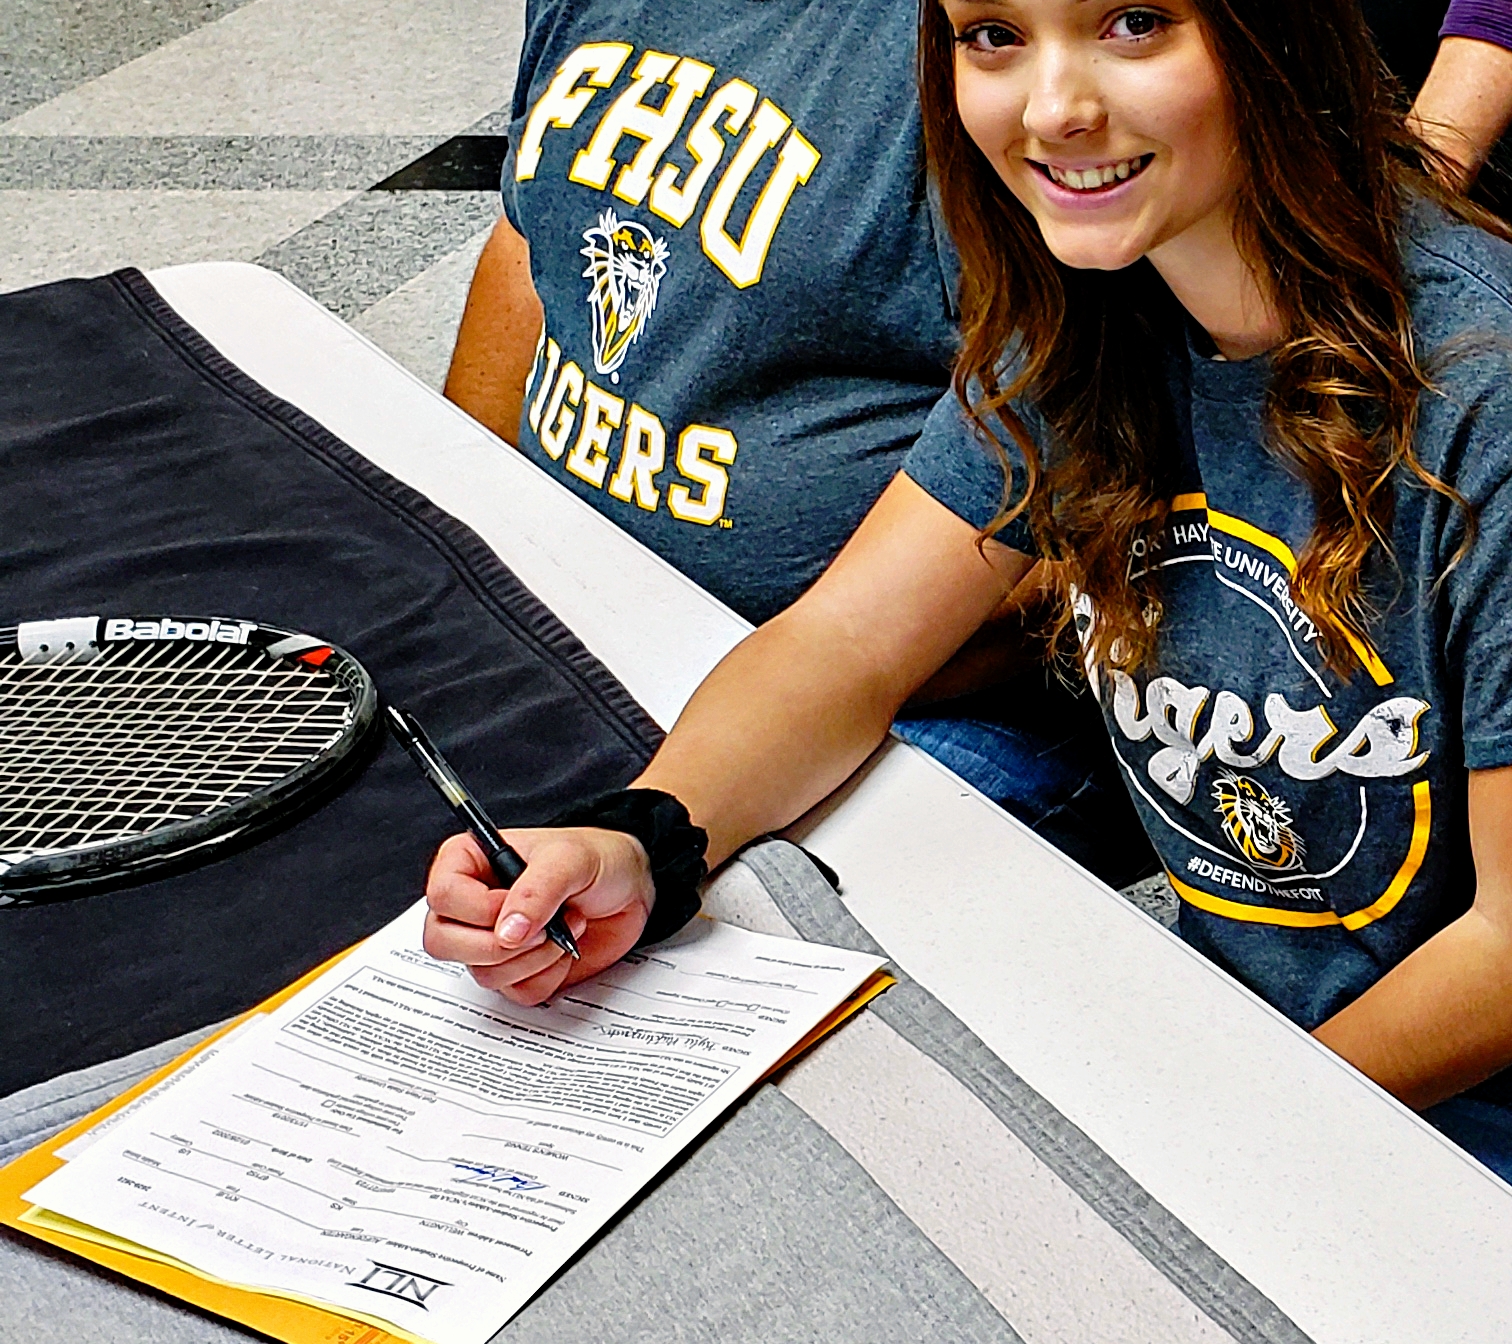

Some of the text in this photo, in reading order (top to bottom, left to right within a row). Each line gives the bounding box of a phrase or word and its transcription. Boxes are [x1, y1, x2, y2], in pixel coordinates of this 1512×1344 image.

[515, 41, 822, 290] FHSU
[525, 318, 738, 526] IGERS
[1173, 523, 1211, 545] HAY
[104, 618, 258, 646] Babolat
[139, 1202, 196, 1226] INTENT
[217, 1230, 274, 1259] LETTER
[359, 1266, 440, 1303] NLI
